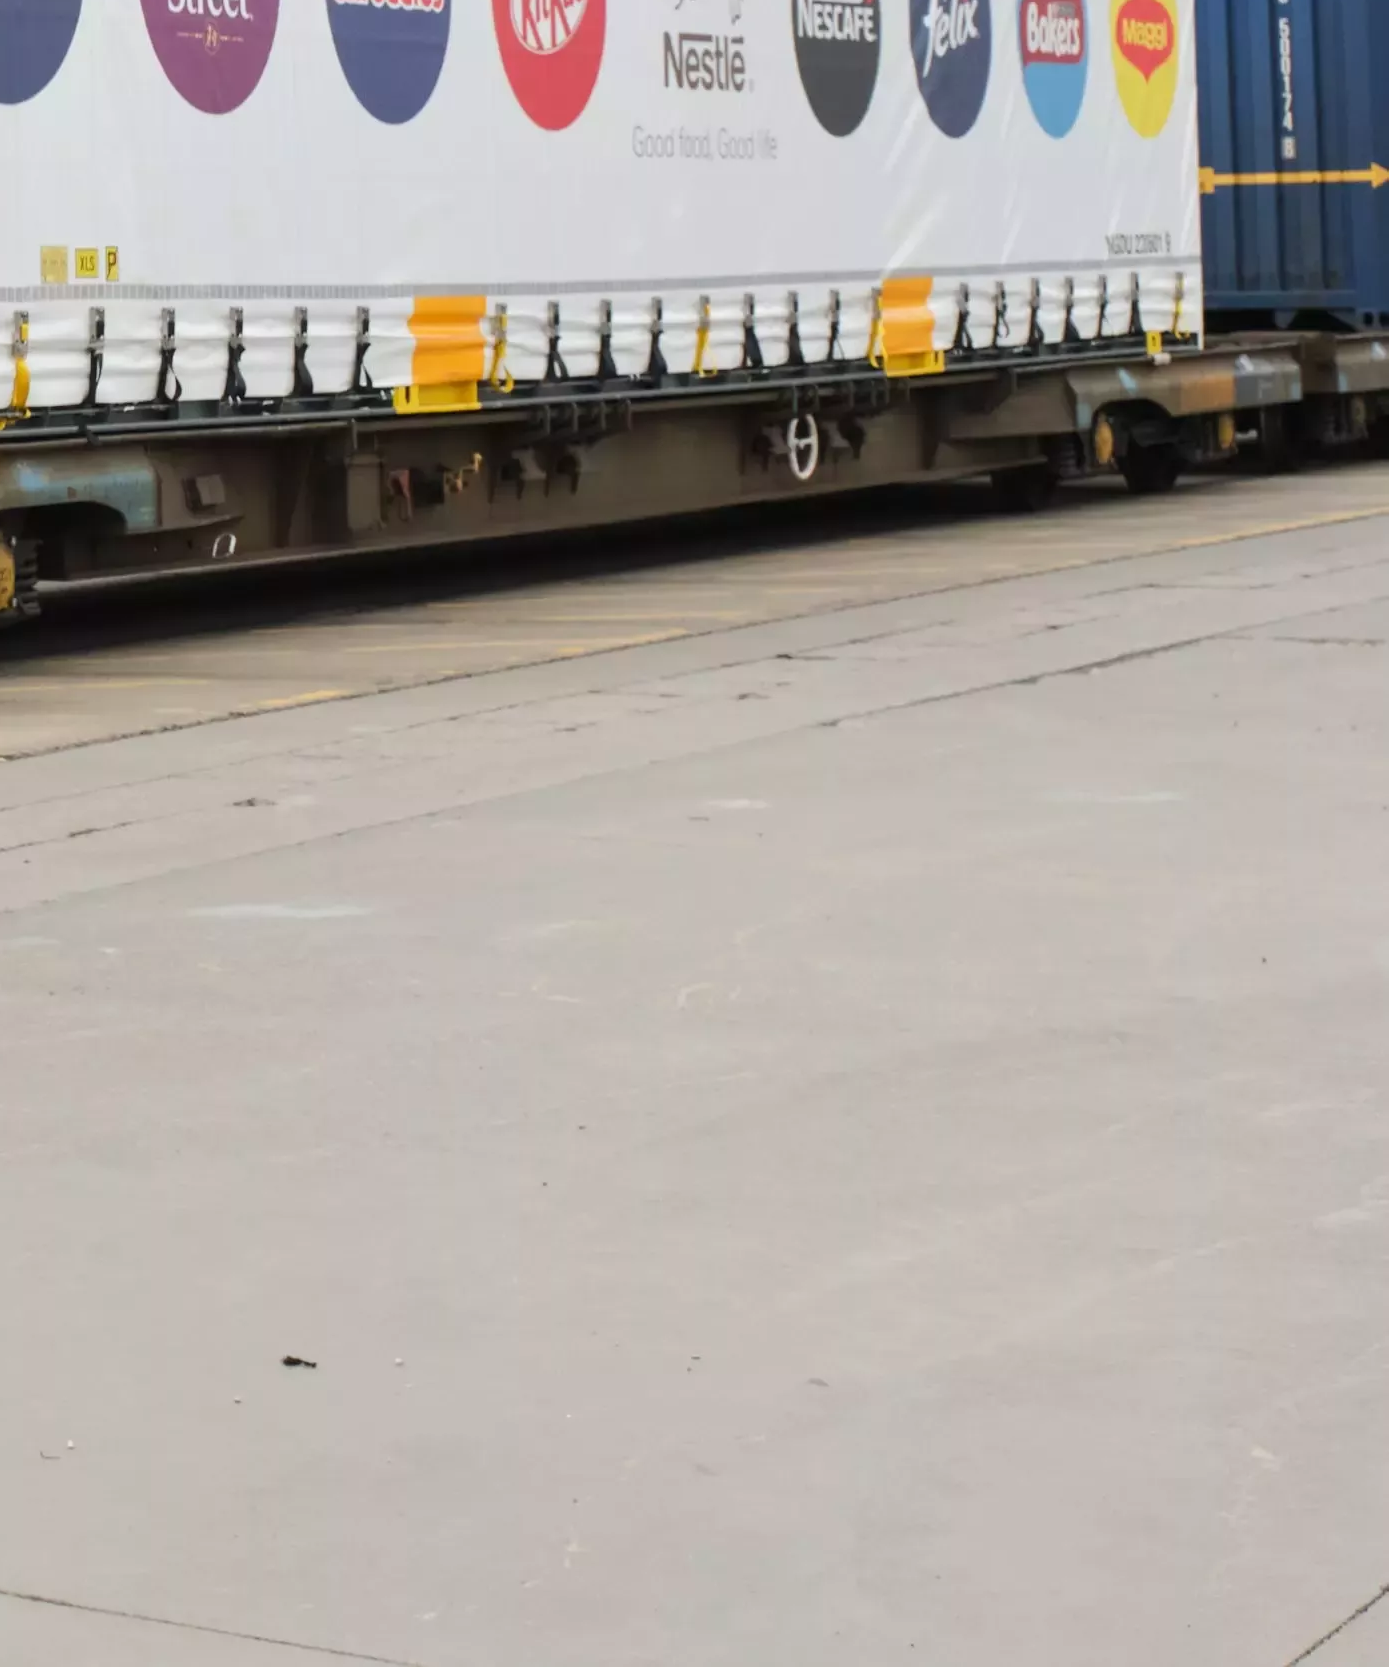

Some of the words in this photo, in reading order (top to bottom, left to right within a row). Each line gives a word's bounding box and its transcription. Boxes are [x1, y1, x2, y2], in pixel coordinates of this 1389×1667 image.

[1026, 0, 1081, 58] Bakers
[1122, 17, 1169, 51] Maggi
[662, 30, 746, 93] Nestlé
[631, 125, 675, 159] Good
[718, 127, 755, 160] Good
[79, 255, 95, 272] XLS
